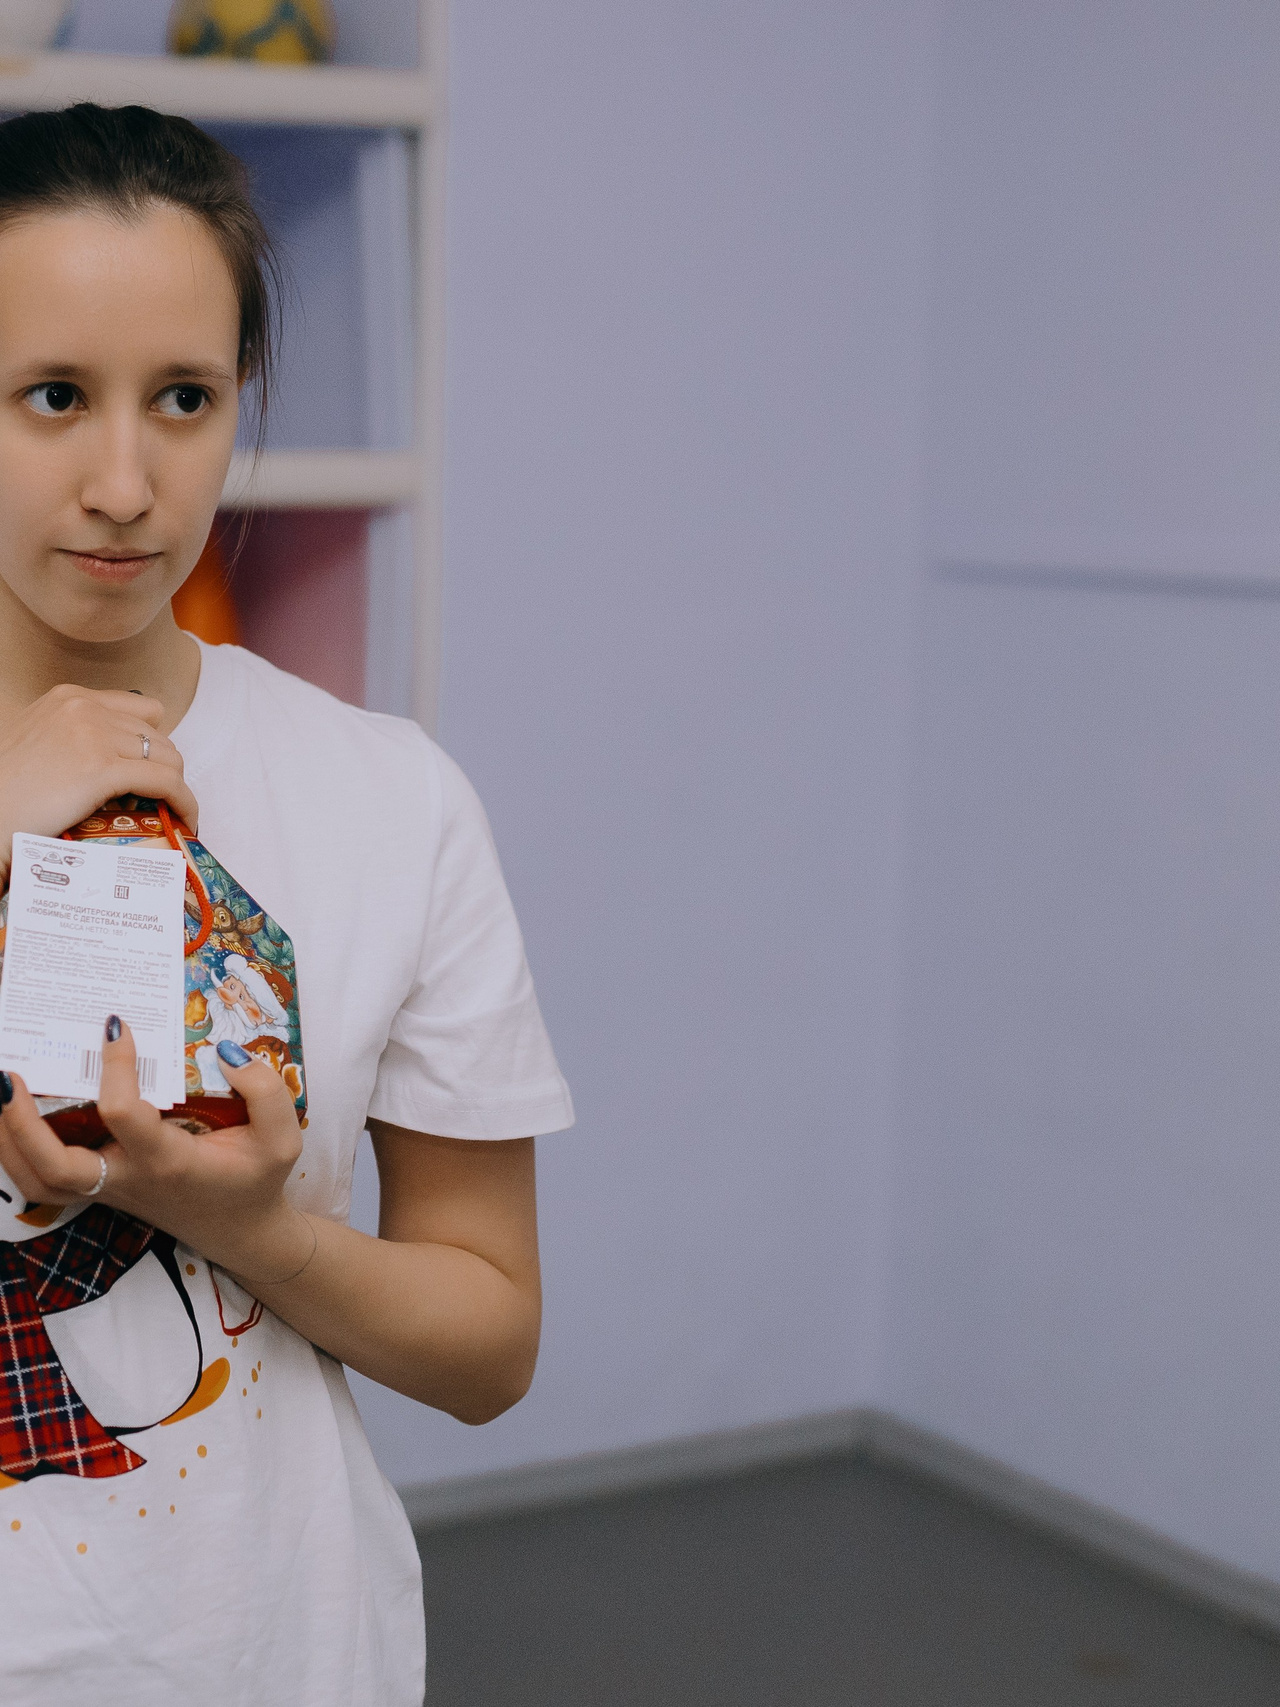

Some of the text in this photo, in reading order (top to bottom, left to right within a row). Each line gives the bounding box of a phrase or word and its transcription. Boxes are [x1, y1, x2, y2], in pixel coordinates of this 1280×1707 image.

[26, 906, 71, 919] «ЛЮБИМЫЕ
[80, 915, 120, 927] ДЕТСТВА»
[121, 921, 164, 933] МАСКАРАД
[32, 899, 159, 923] НАБОР КОНДИТЕРСКИХ ИЗДЕЛИЙ
[59, 922, 84, 931] МАССА
[85, 925, 110, 935] НЕТТО:
